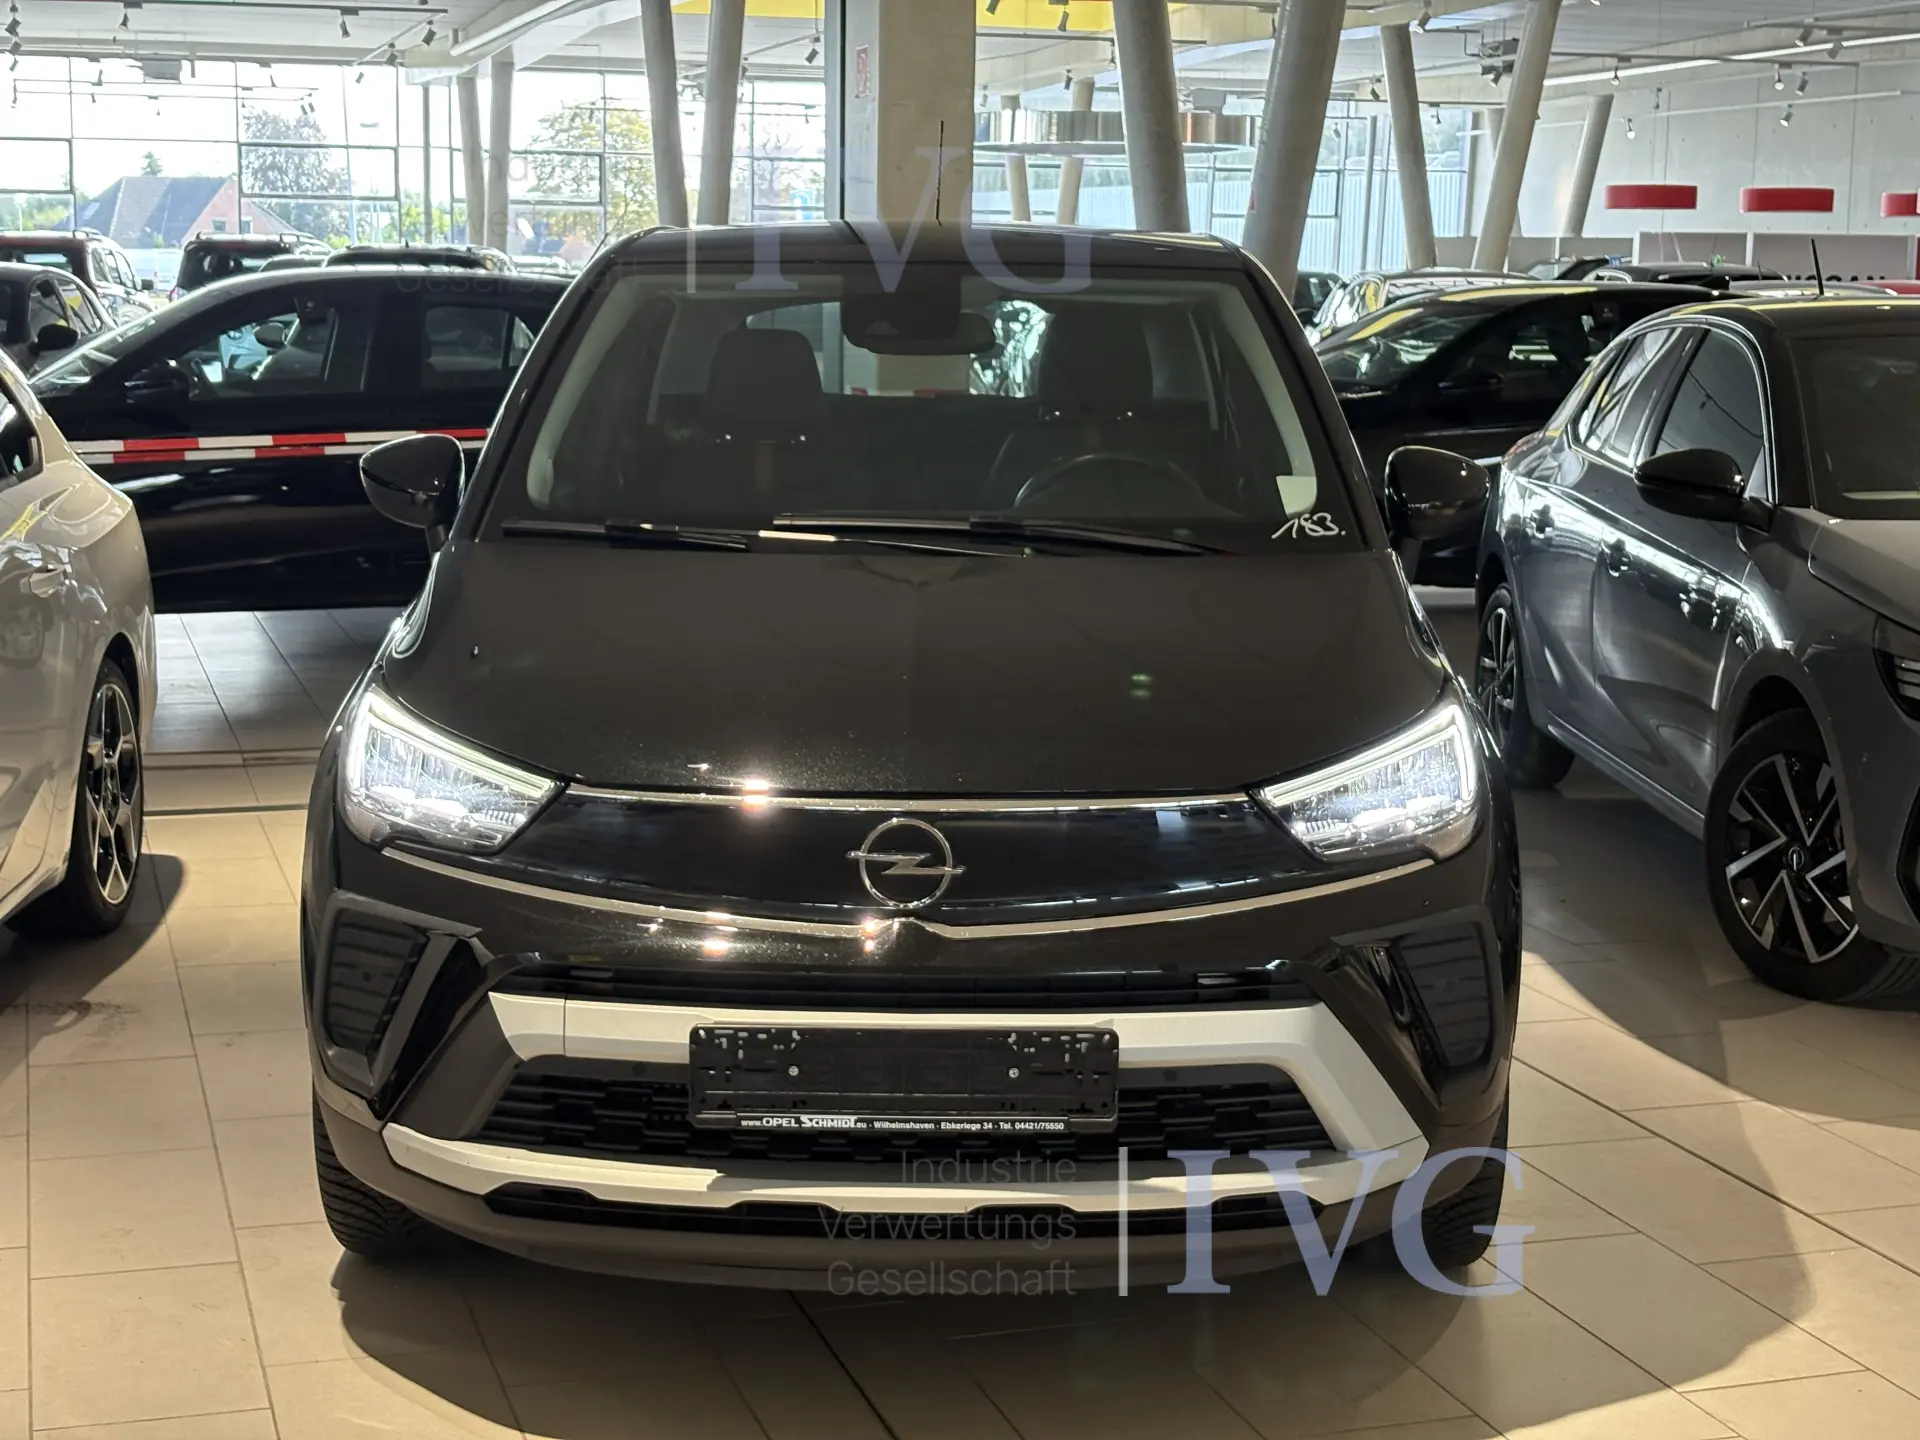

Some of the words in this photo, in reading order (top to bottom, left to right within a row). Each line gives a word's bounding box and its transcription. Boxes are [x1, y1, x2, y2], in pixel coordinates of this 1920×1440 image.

[873, 1121, 935, 1130] Wilhelmshaven
[982, 1122, 993, 1130] 34
[999, 1122, 1013, 1130] Tel.
[1015, 1122, 1065, 1130] 04421/75550
